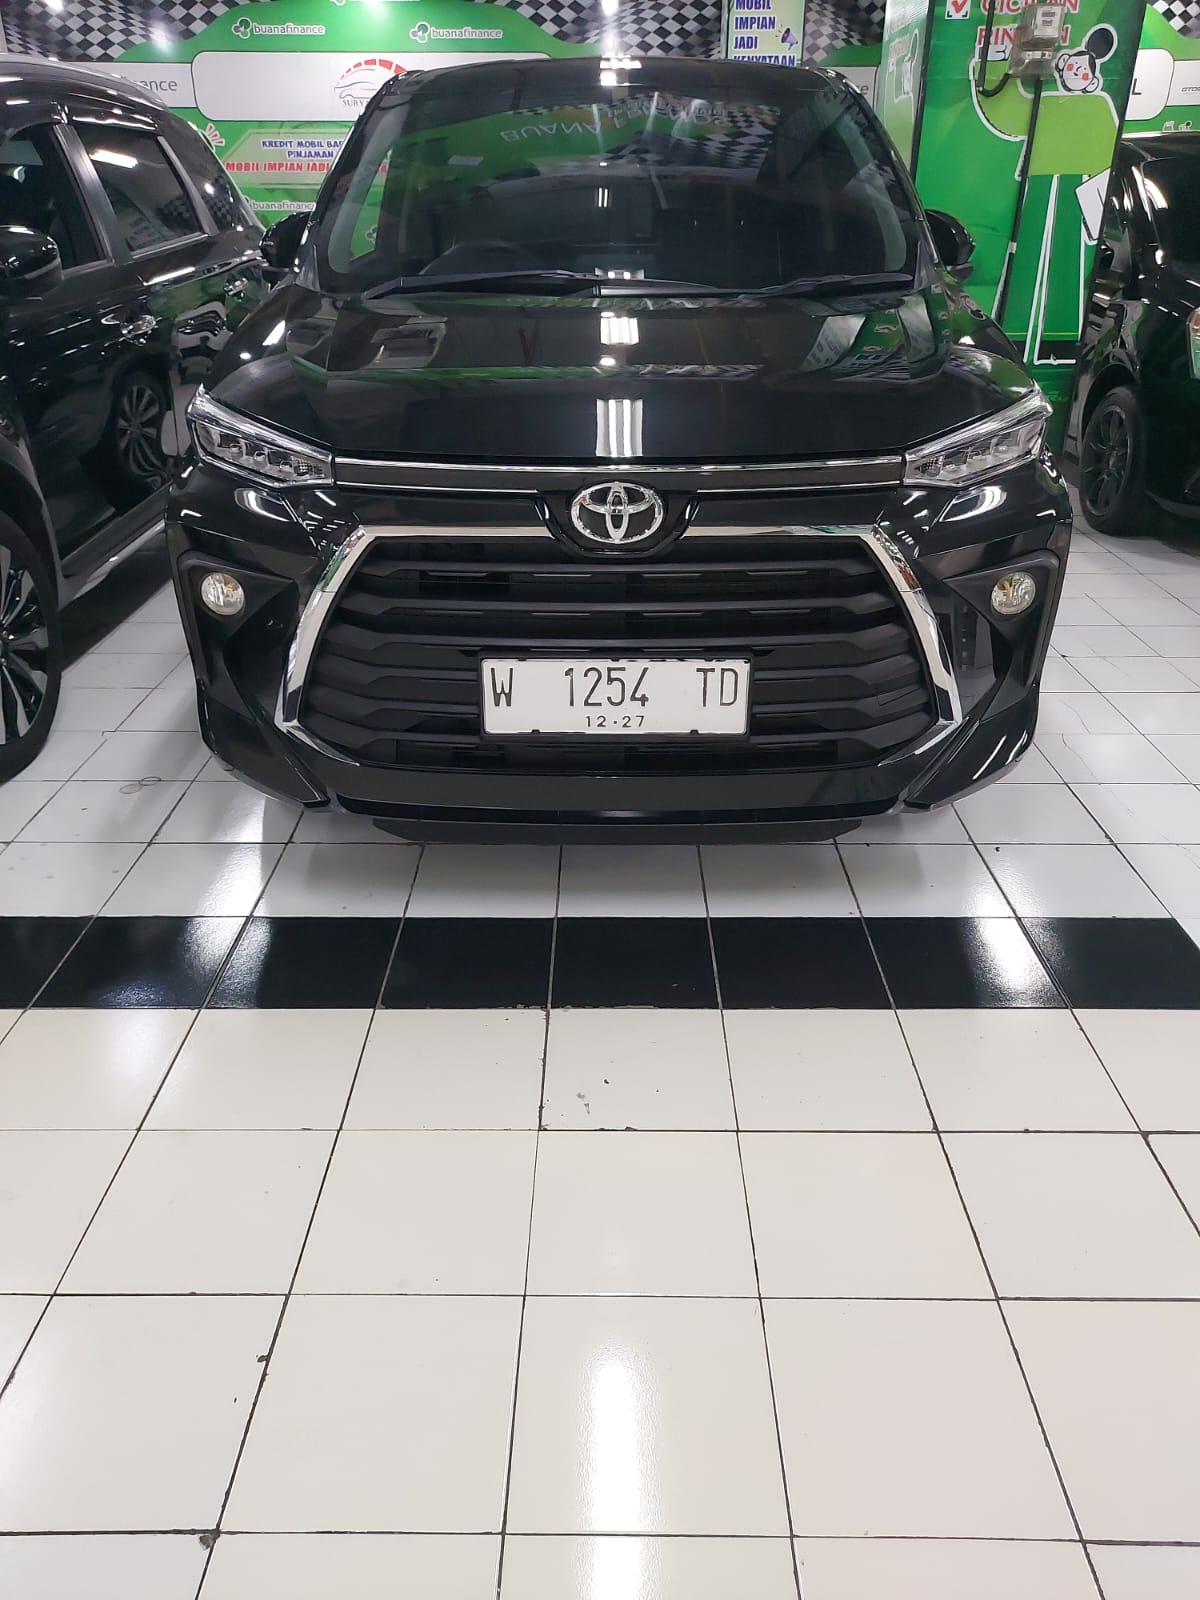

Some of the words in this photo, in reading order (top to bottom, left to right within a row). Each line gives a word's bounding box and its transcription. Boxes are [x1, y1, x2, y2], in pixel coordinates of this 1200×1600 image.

[735, 16, 776, 30] IMPIAN
[254, 24, 324, 35] buanafinance
[432, 28, 501, 38] buanafinance
[734, 36, 758, 49] JADI
[262, 140, 293, 148] KREDIT
[297, 140, 323, 148] MOBIL
[287, 150, 334, 158] PINJAMAN
[225, 162, 259, 171] MOBIL
[264, 163, 303, 171] IMPIAN
[490, 667, 513, 707] W
[564, 666, 649, 707] 1254
[696, 667, 739, 707] TD
